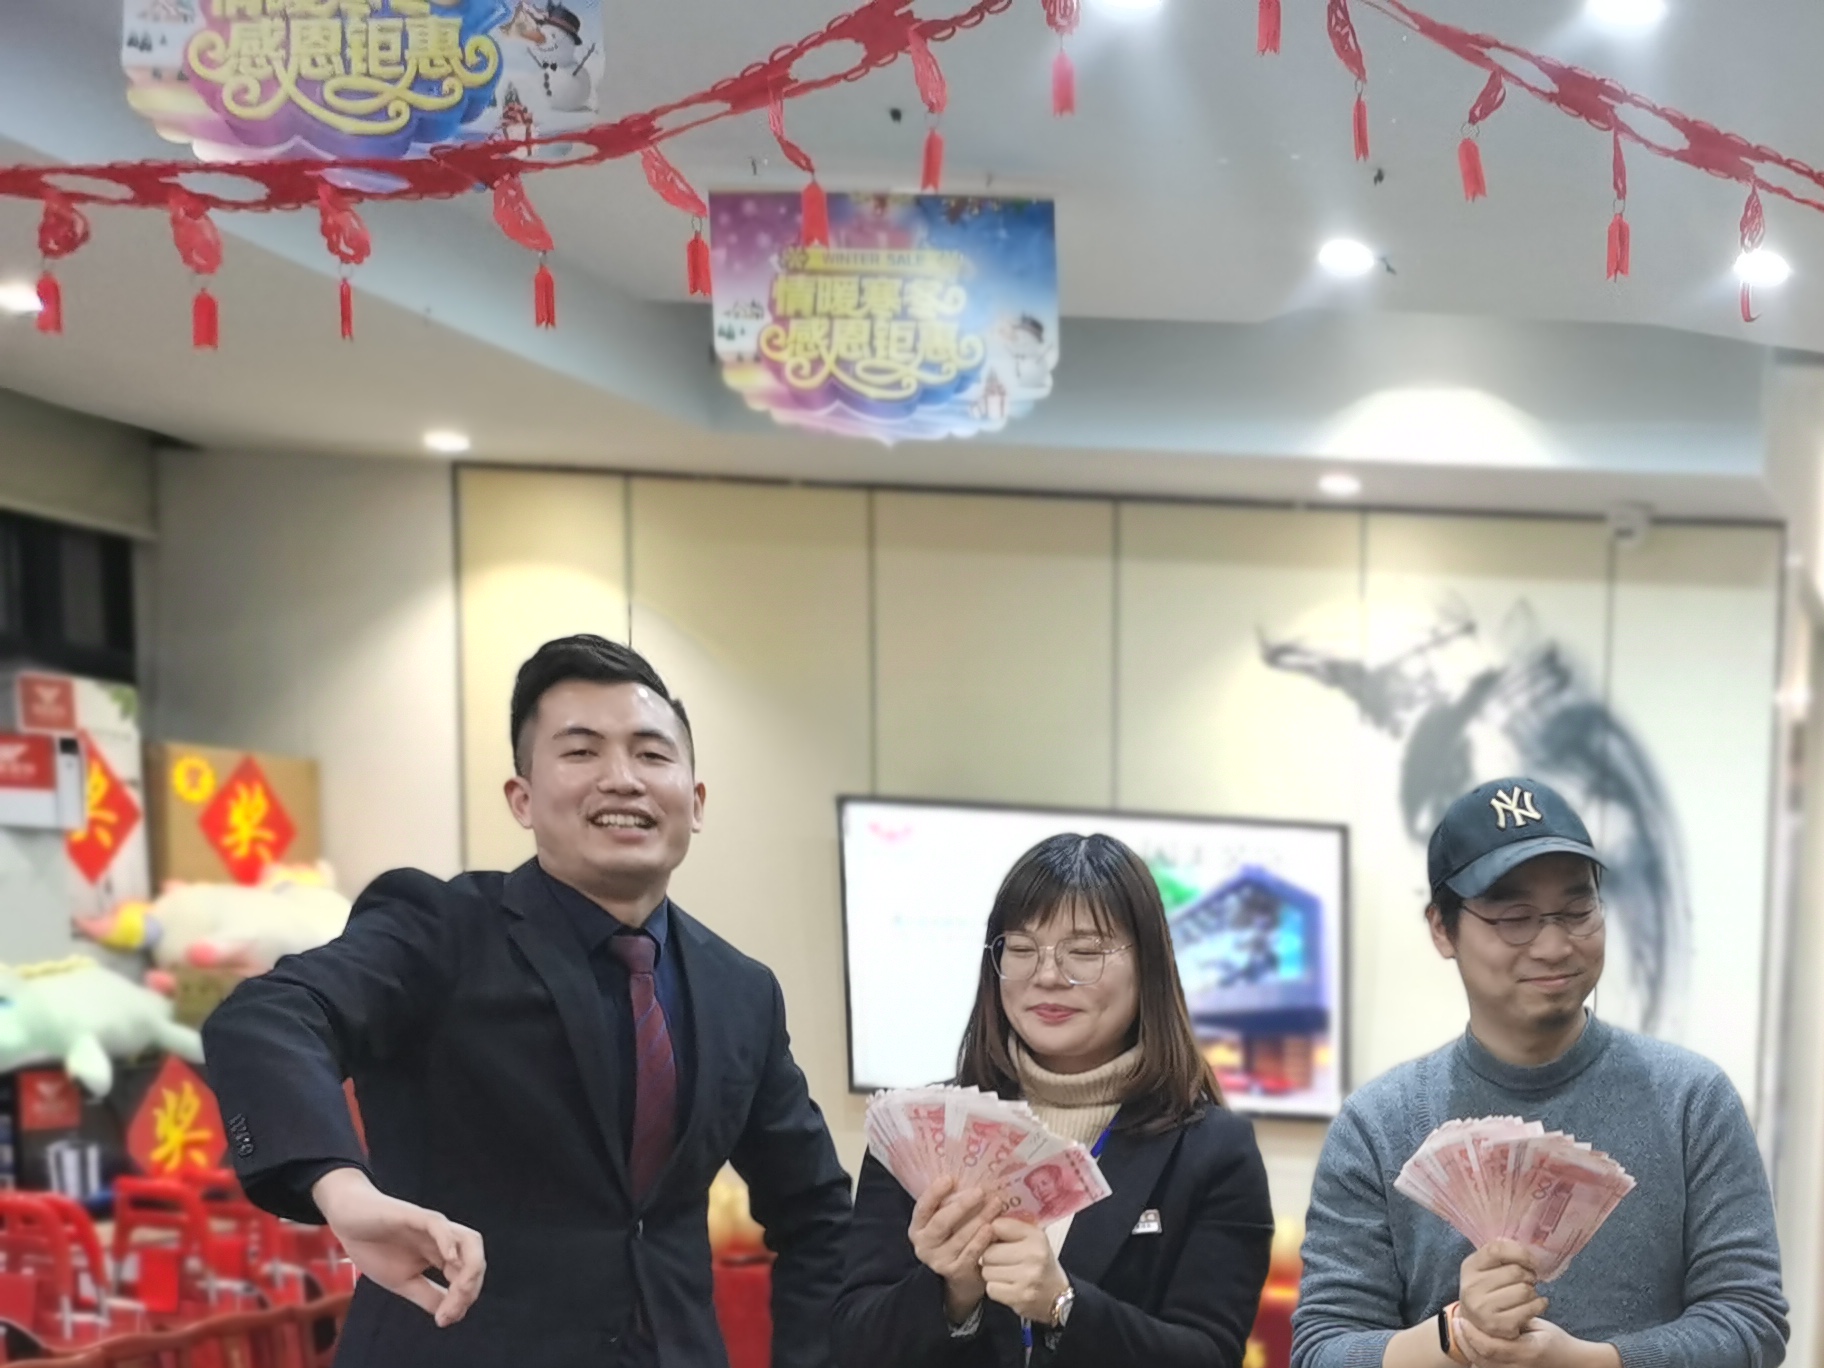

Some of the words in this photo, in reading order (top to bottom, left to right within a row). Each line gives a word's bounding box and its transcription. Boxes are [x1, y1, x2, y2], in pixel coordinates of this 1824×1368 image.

[190, 16, 498, 80] 感恩钜惠
[771, 274, 967, 318] 情暖寒冬
[761, 317, 984, 364] 感恩钜惠
[1490, 786, 1542, 829] NY
